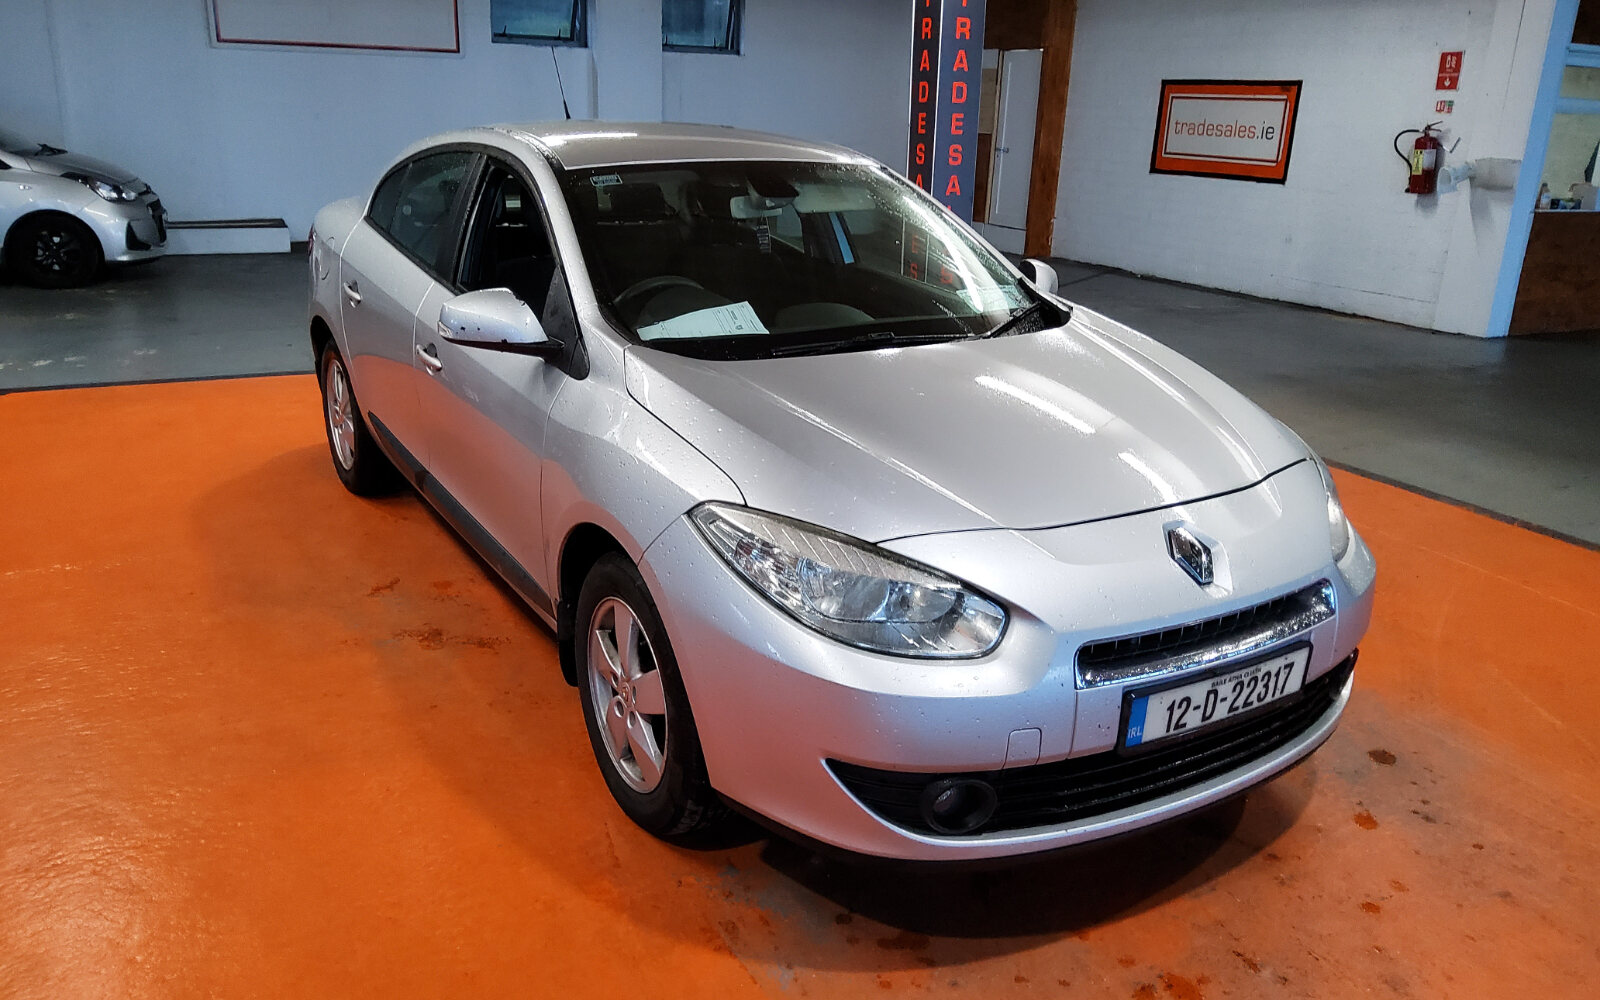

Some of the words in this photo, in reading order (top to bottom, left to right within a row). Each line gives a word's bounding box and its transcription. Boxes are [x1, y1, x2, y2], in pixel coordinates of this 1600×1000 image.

[1174, 118, 1275, 140] tradesales.ie
[1166, 661, 1295, 734] 12-D-22317
[1127, 726, 1143, 739] IRL
